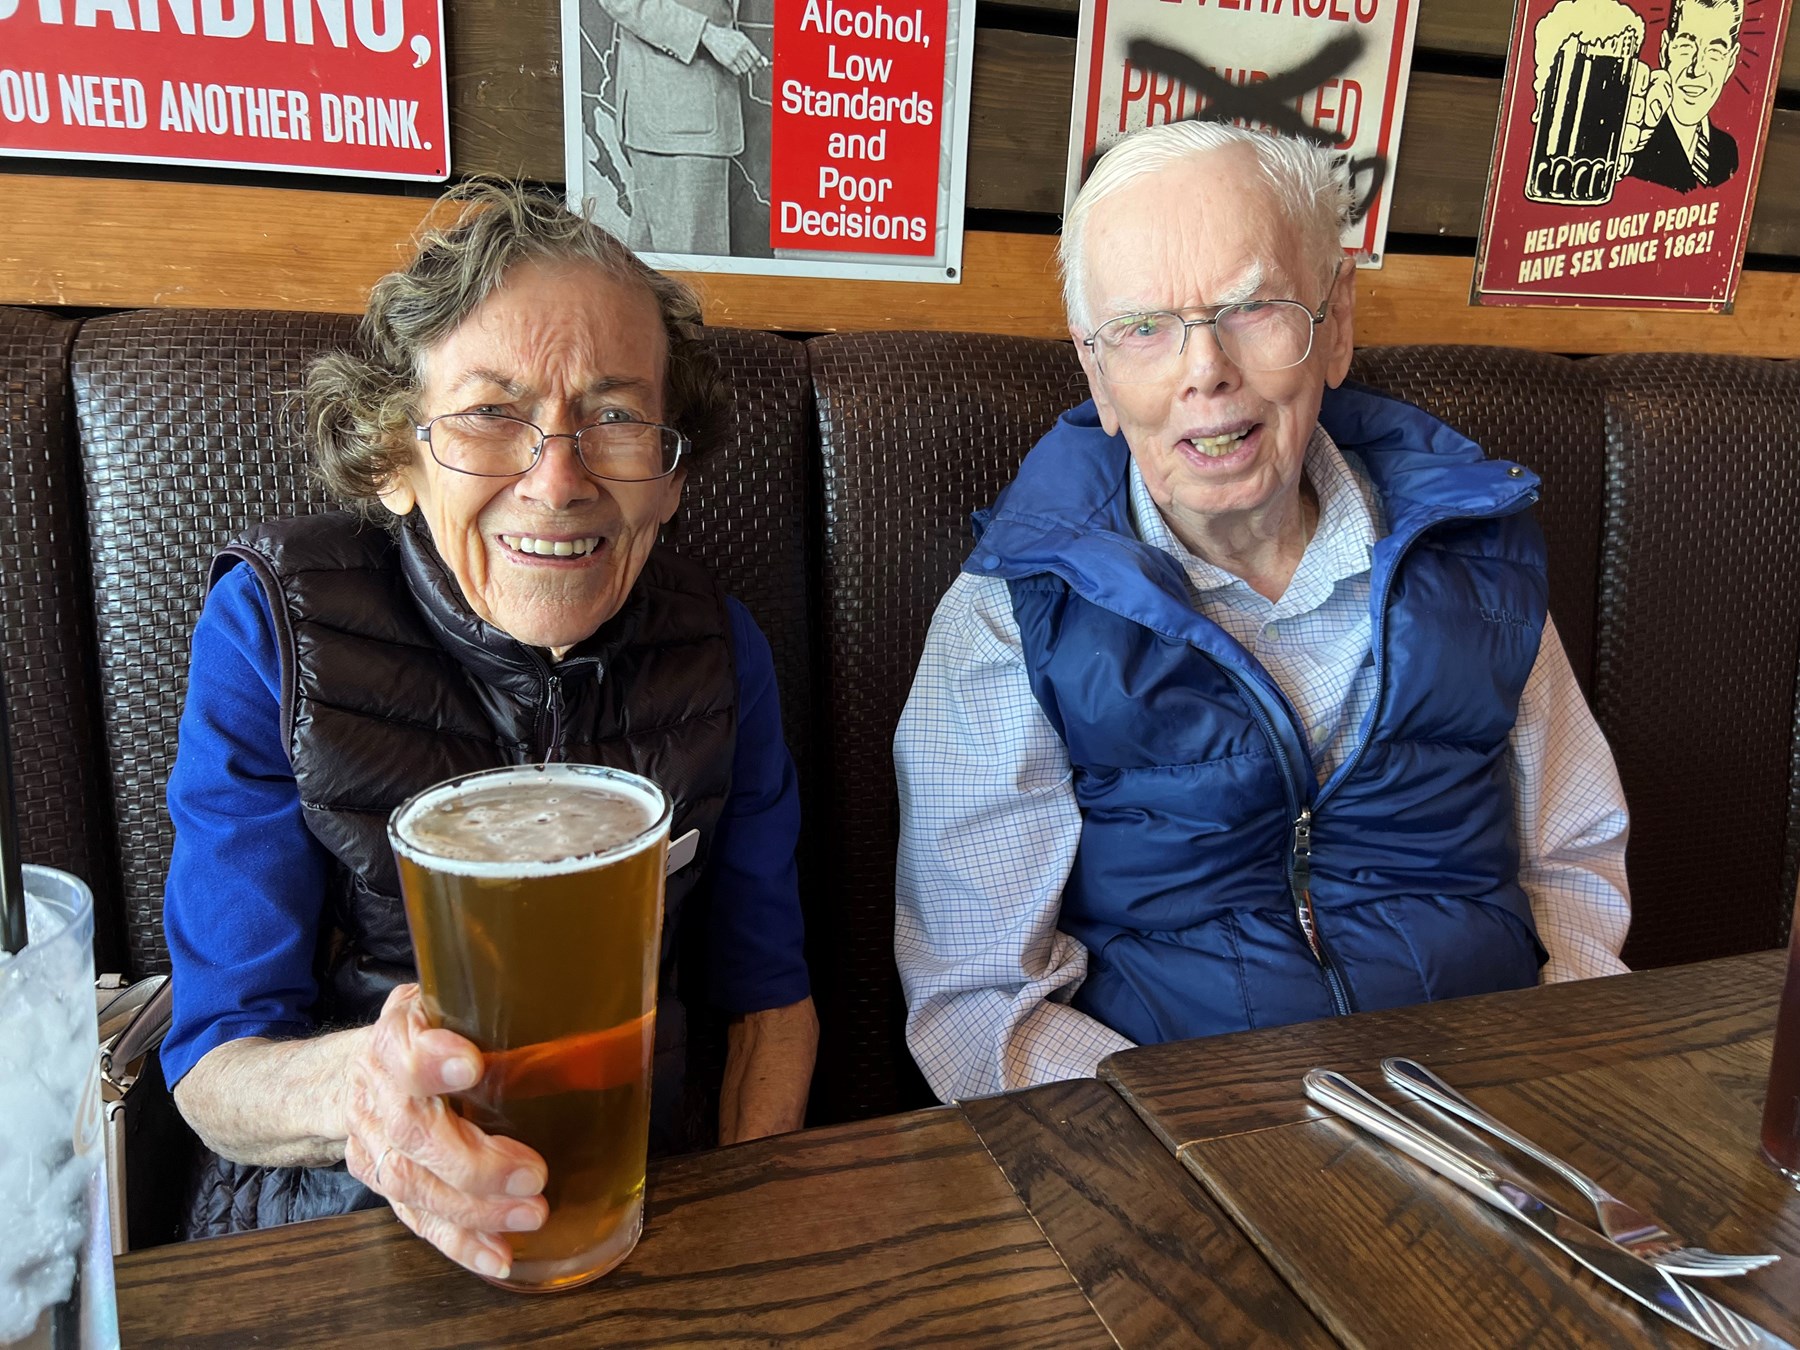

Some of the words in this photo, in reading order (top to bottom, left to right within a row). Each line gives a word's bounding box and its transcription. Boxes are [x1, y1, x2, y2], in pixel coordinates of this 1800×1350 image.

[800, 0, 930, 48] Alcohol,
[828, 45, 893, 83] Low
[0, 69, 50, 124] OU
[58, 73, 148, 129] NEED
[160, 80, 312, 141] ANOTHER
[319, 93, 432, 150] DRINK.
[781, 79, 933, 126] Standards
[828, 128, 886, 161] and
[819, 166, 893, 202] Poor
[781, 201, 927, 242] Decisions
[1523, 220, 1602, 254] HELPING
[1605, 212, 1650, 241] UGLY
[1652, 202, 1720, 233] PEOPLE
[1517, 254, 1566, 284] HAVE
[1608, 239, 1659, 269] SINCE
[1664, 230, 1715, 259] 1862!
